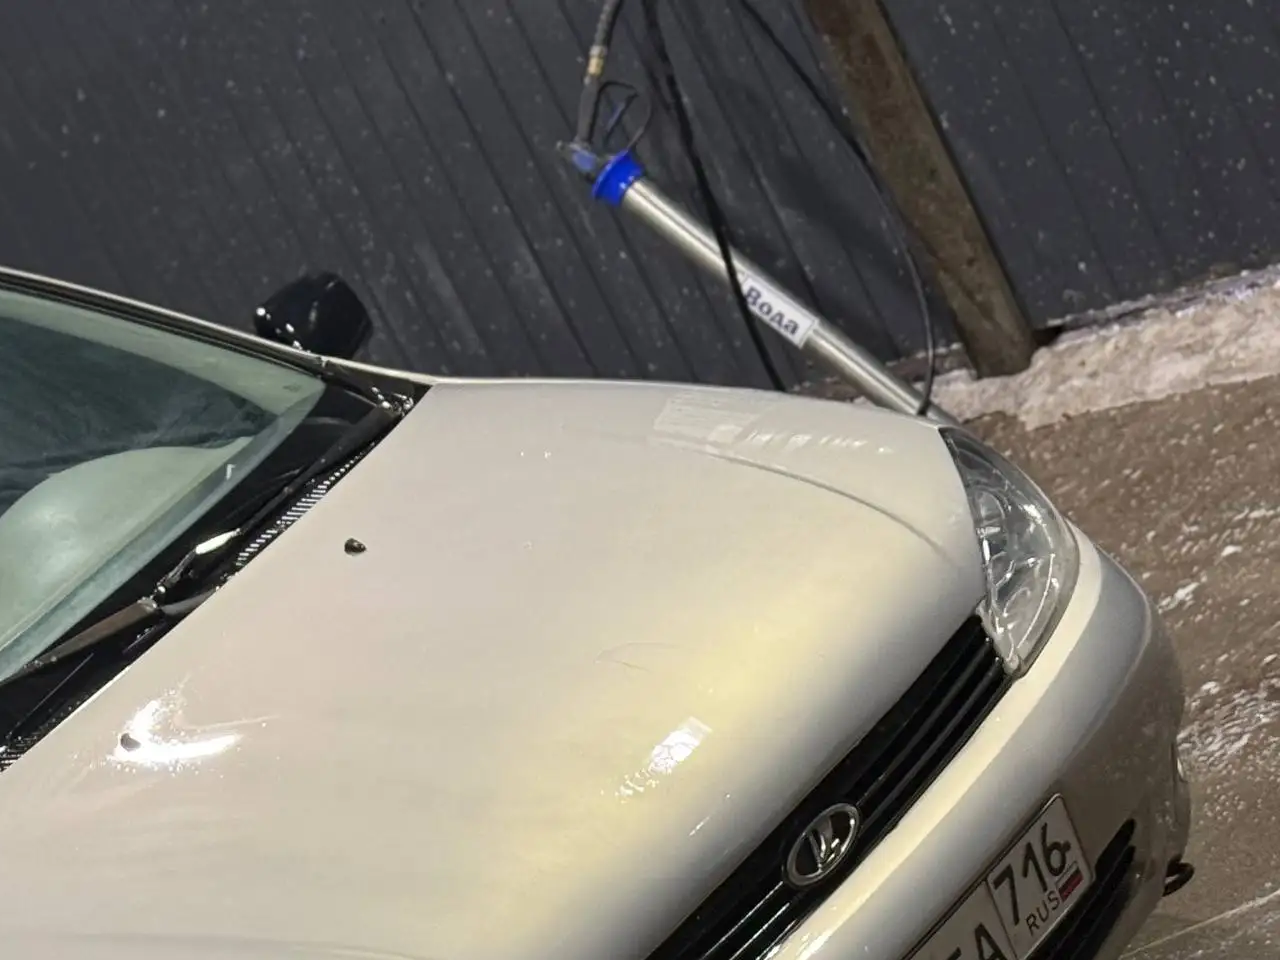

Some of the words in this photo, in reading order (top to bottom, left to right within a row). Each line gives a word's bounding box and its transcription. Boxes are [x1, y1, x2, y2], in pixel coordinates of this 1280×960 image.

[745, 286, 800, 335] Вода
[993, 822, 1066, 926] 716
[1026, 890, 1060, 936] RUS
